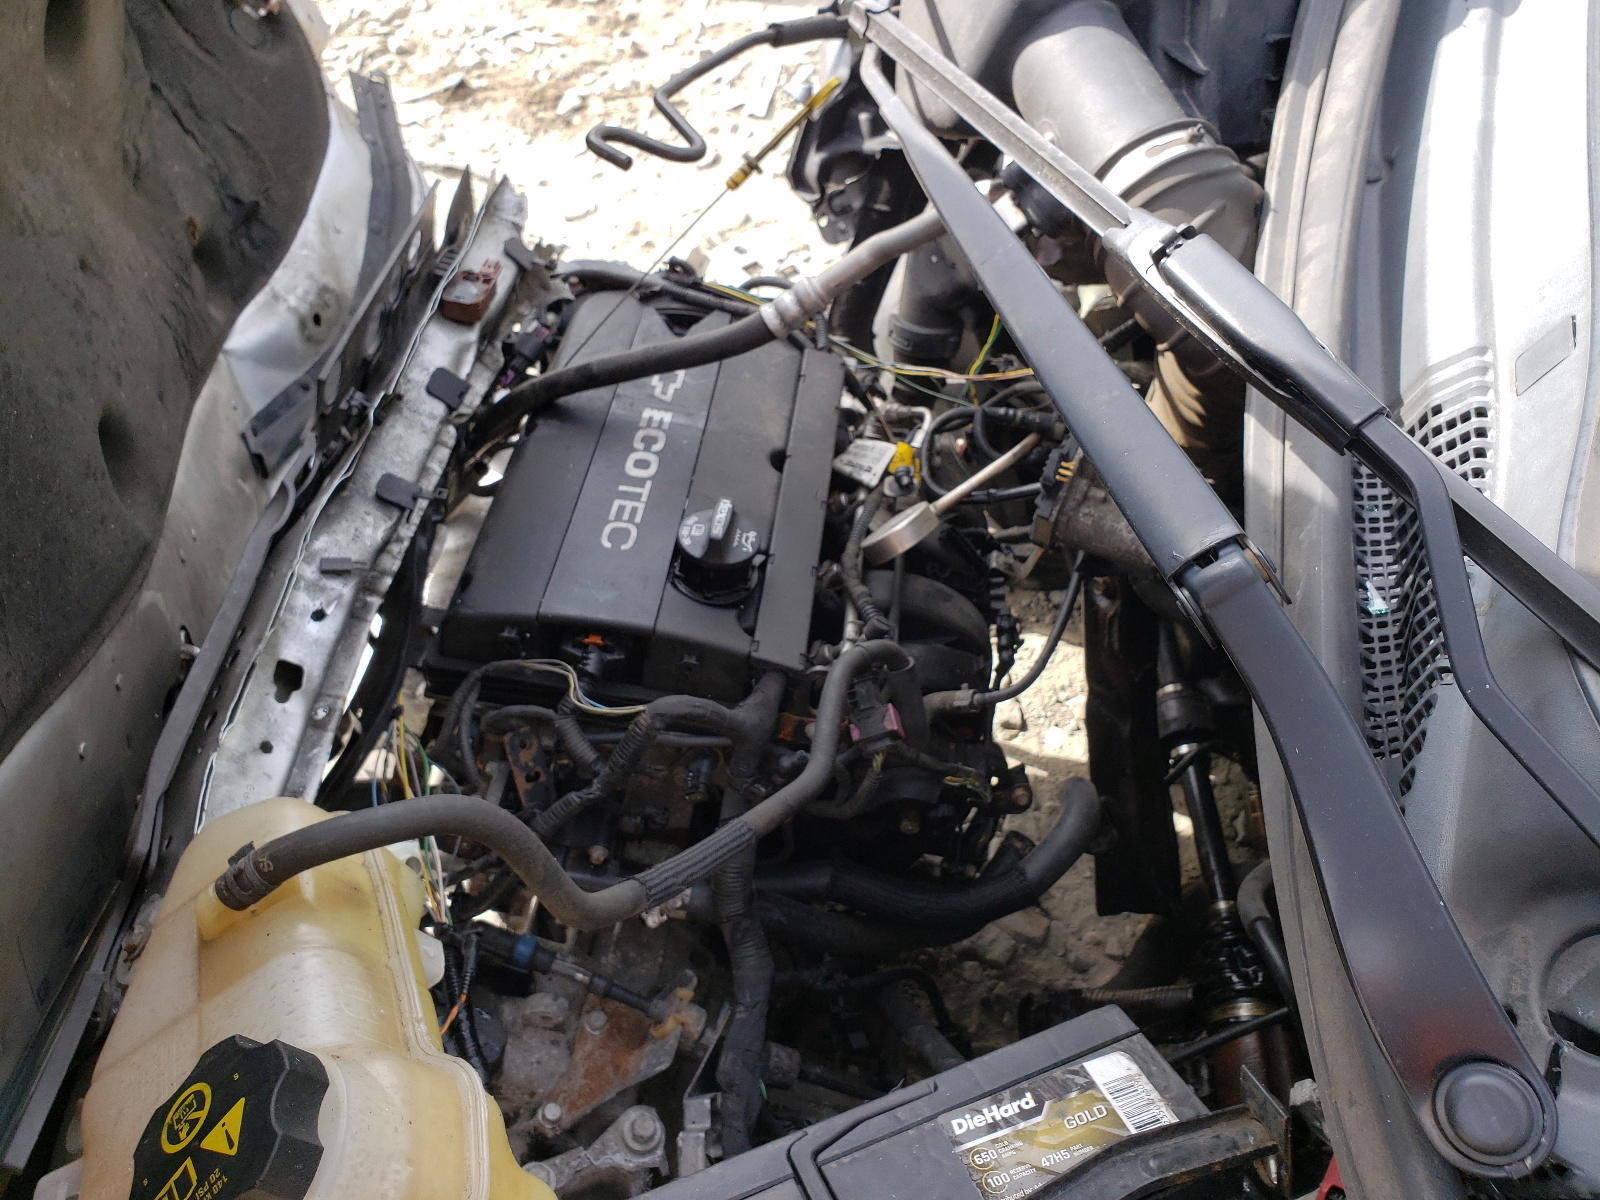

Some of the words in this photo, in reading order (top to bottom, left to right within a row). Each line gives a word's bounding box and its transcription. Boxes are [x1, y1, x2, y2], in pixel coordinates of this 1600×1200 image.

[600, 406, 673, 551] ECOTEC
[710, 499, 734, 536] dexos
[951, 1092, 1036, 1135] DieHard
[1064, 1104, 1107, 1130] GOLD
[973, 1148, 998, 1166] 650
[1040, 1148, 1071, 1168] 47H5
[209, 1167, 221, 1184] 20
[212, 1174, 228, 1195] 140
[987, 1172, 1011, 1188] 100
[195, 1180, 209, 1200] PSI
